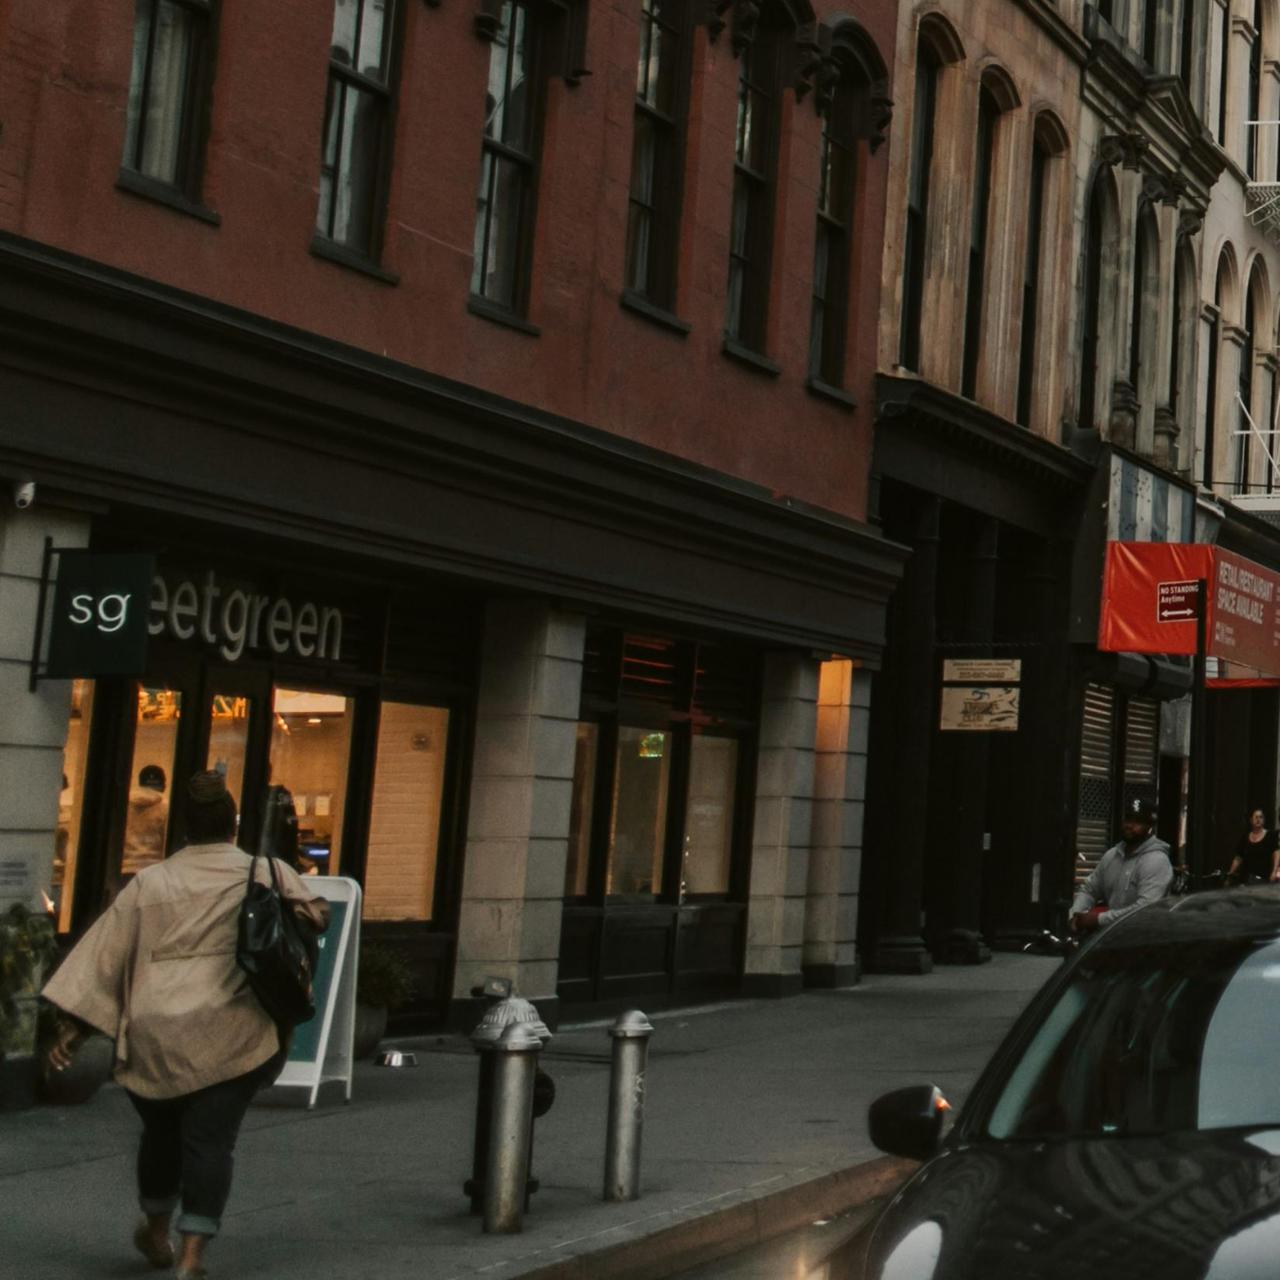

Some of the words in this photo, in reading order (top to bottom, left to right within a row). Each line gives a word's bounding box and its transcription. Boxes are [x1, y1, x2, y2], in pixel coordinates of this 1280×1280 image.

[1160, 586, 1169, 595] NO
[1170, 584, 1200, 594] STANDING
[1160, 595, 1185, 605] Anytime
[1217, 587, 1236, 614] SPACE
[68, 593, 132, 633] sg
[148, 569, 343, 662] eetgreen
